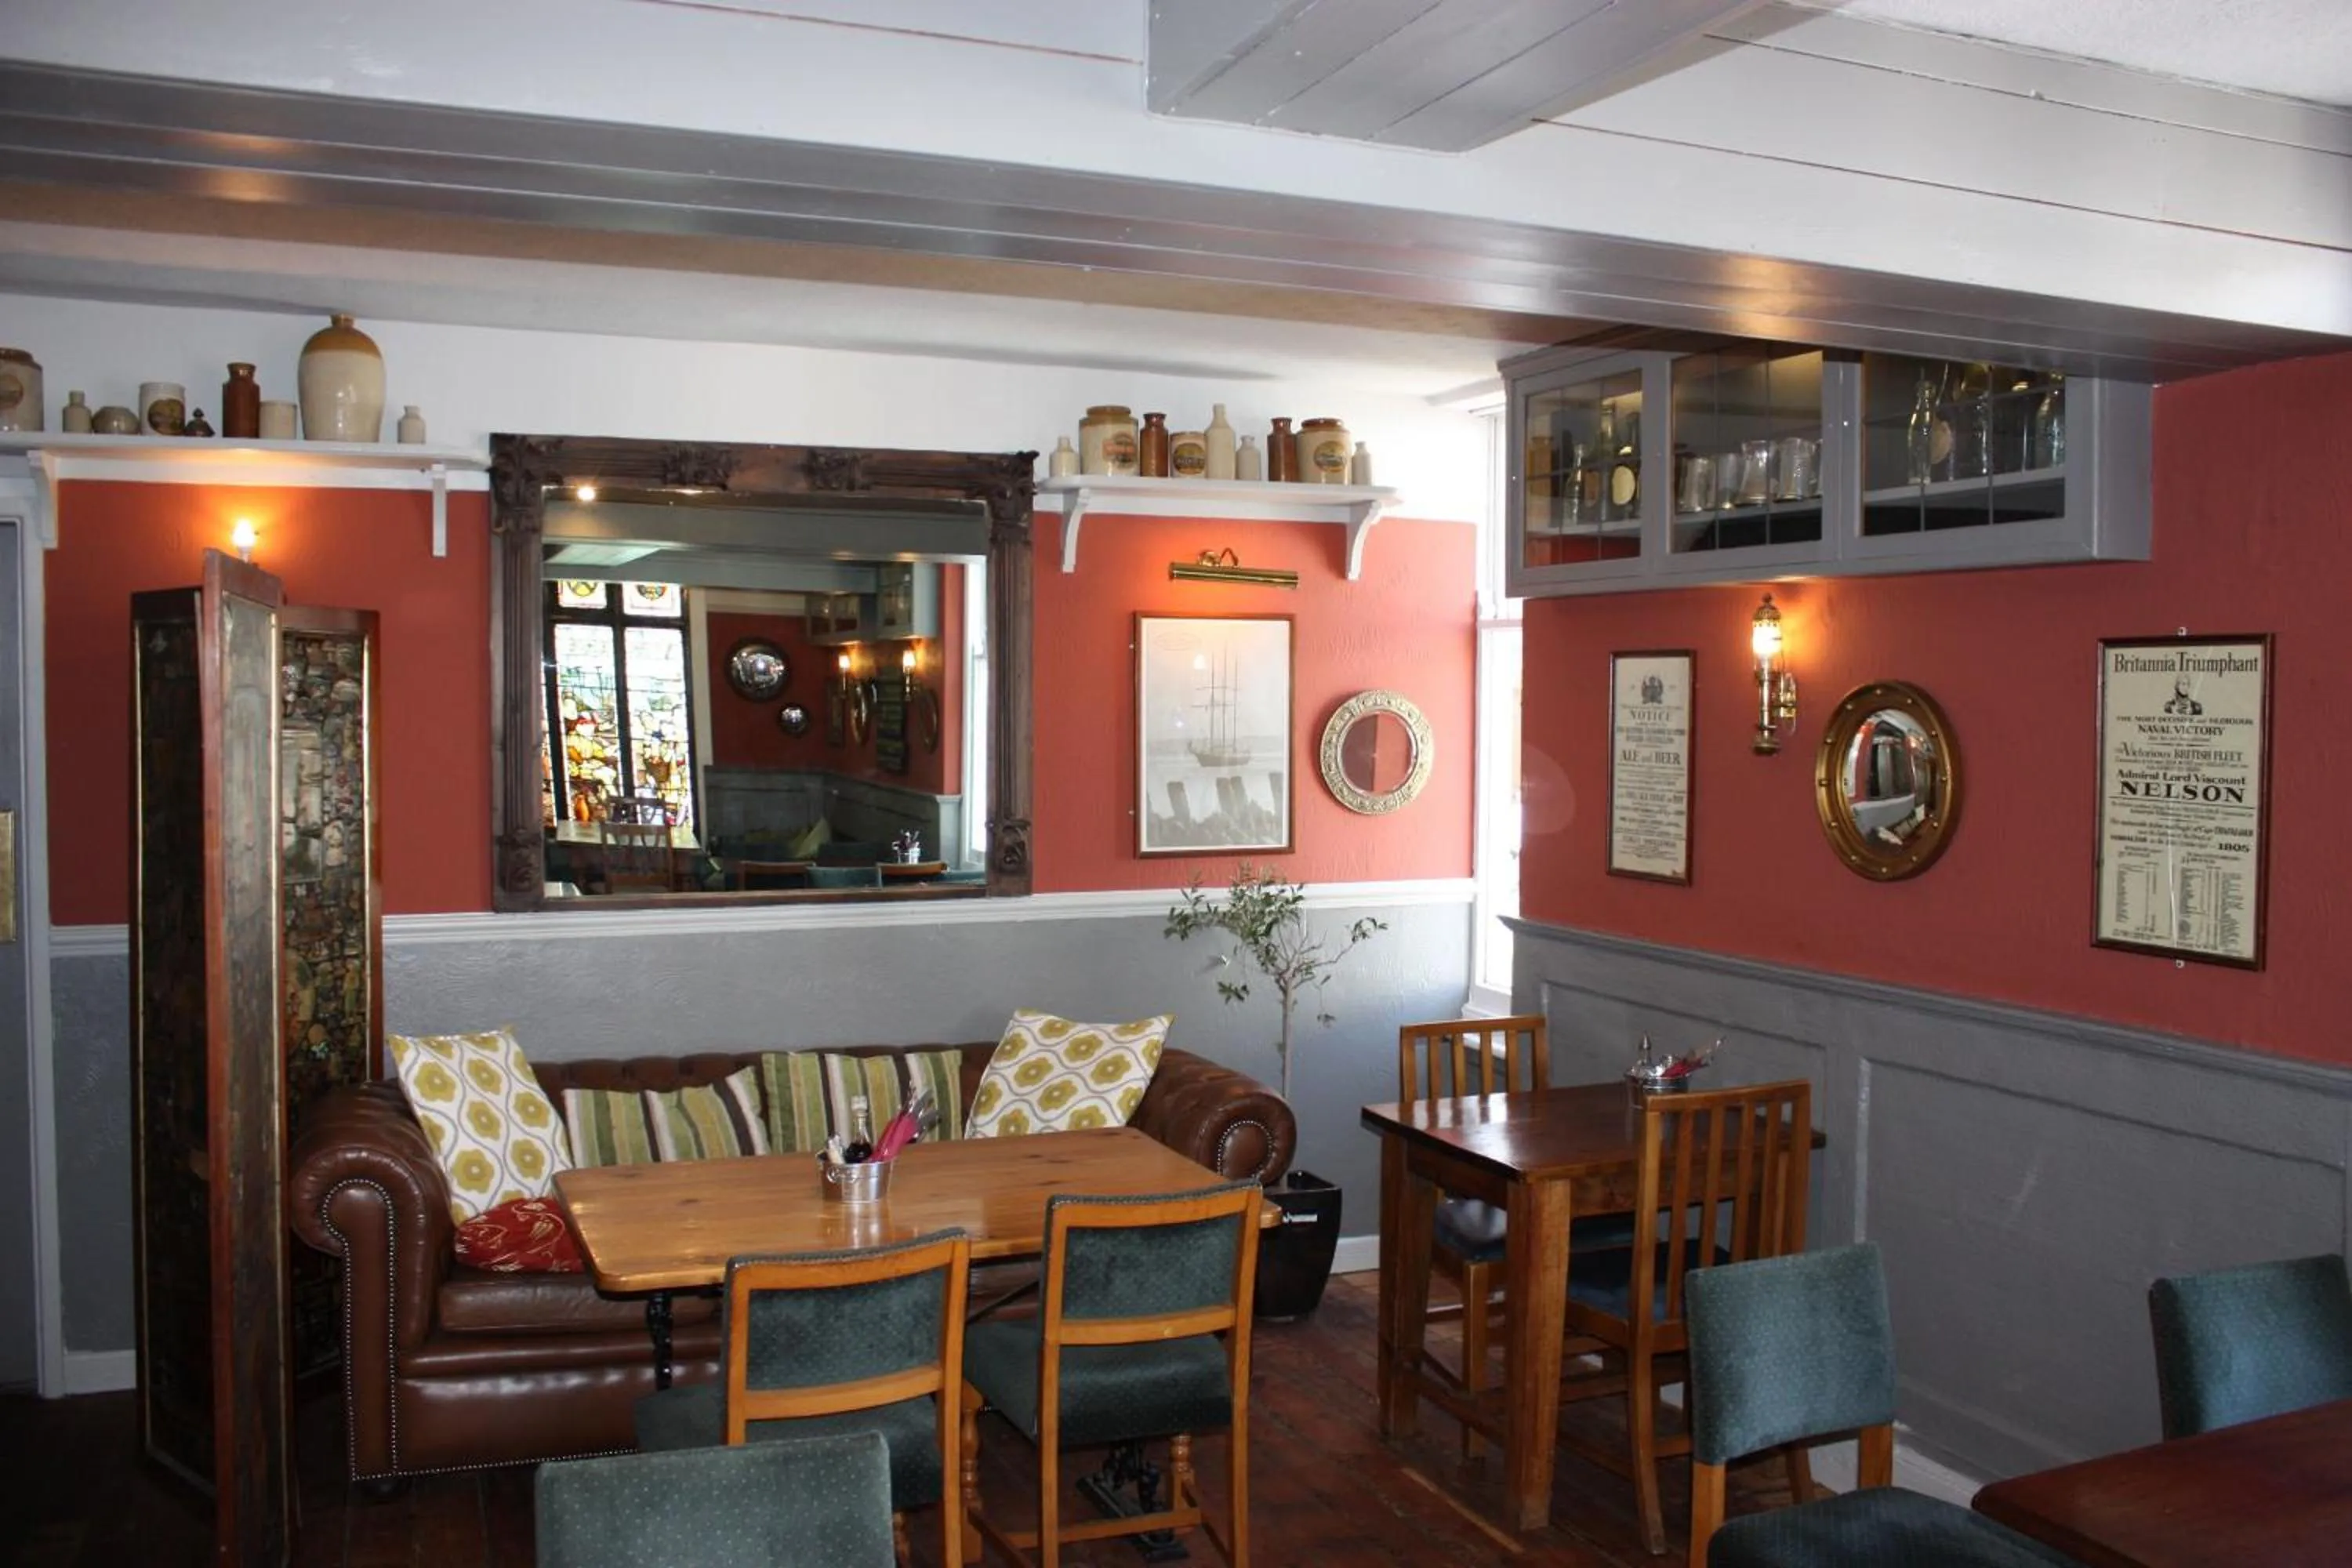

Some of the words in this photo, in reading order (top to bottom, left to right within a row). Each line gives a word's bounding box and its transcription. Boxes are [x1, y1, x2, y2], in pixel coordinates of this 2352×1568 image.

[2114, 654, 2175, 673] Britannia
[2176, 652, 2258, 677] Triumphant
[2138, 724, 2172, 734] NAVAL
[2173, 725, 2225, 735] VICTORY
[2118, 768, 2159, 779] Admiral
[2162, 771, 2190, 782] Lord
[2194, 773, 2246, 785] Viscount
[2120, 782, 2245, 803] NELSON
[2218, 842, 2250, 853] 1805
